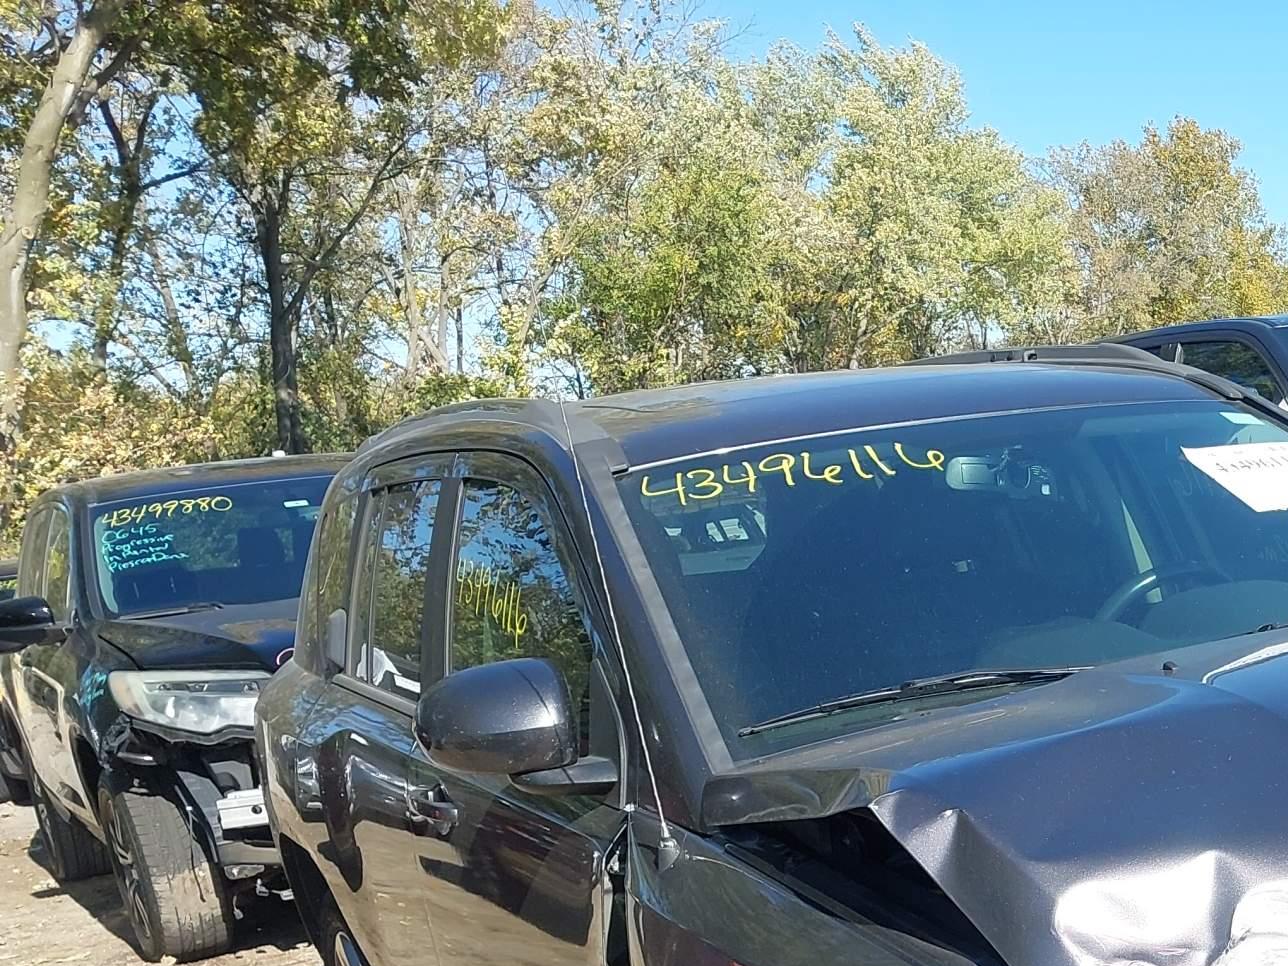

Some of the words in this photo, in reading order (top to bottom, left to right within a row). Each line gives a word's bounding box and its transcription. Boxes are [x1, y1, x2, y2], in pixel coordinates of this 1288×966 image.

[640, 442, 945, 505] 43496116
[102, 496, 232, 528] 43499880
[456, 557, 528, 649] 43496116
